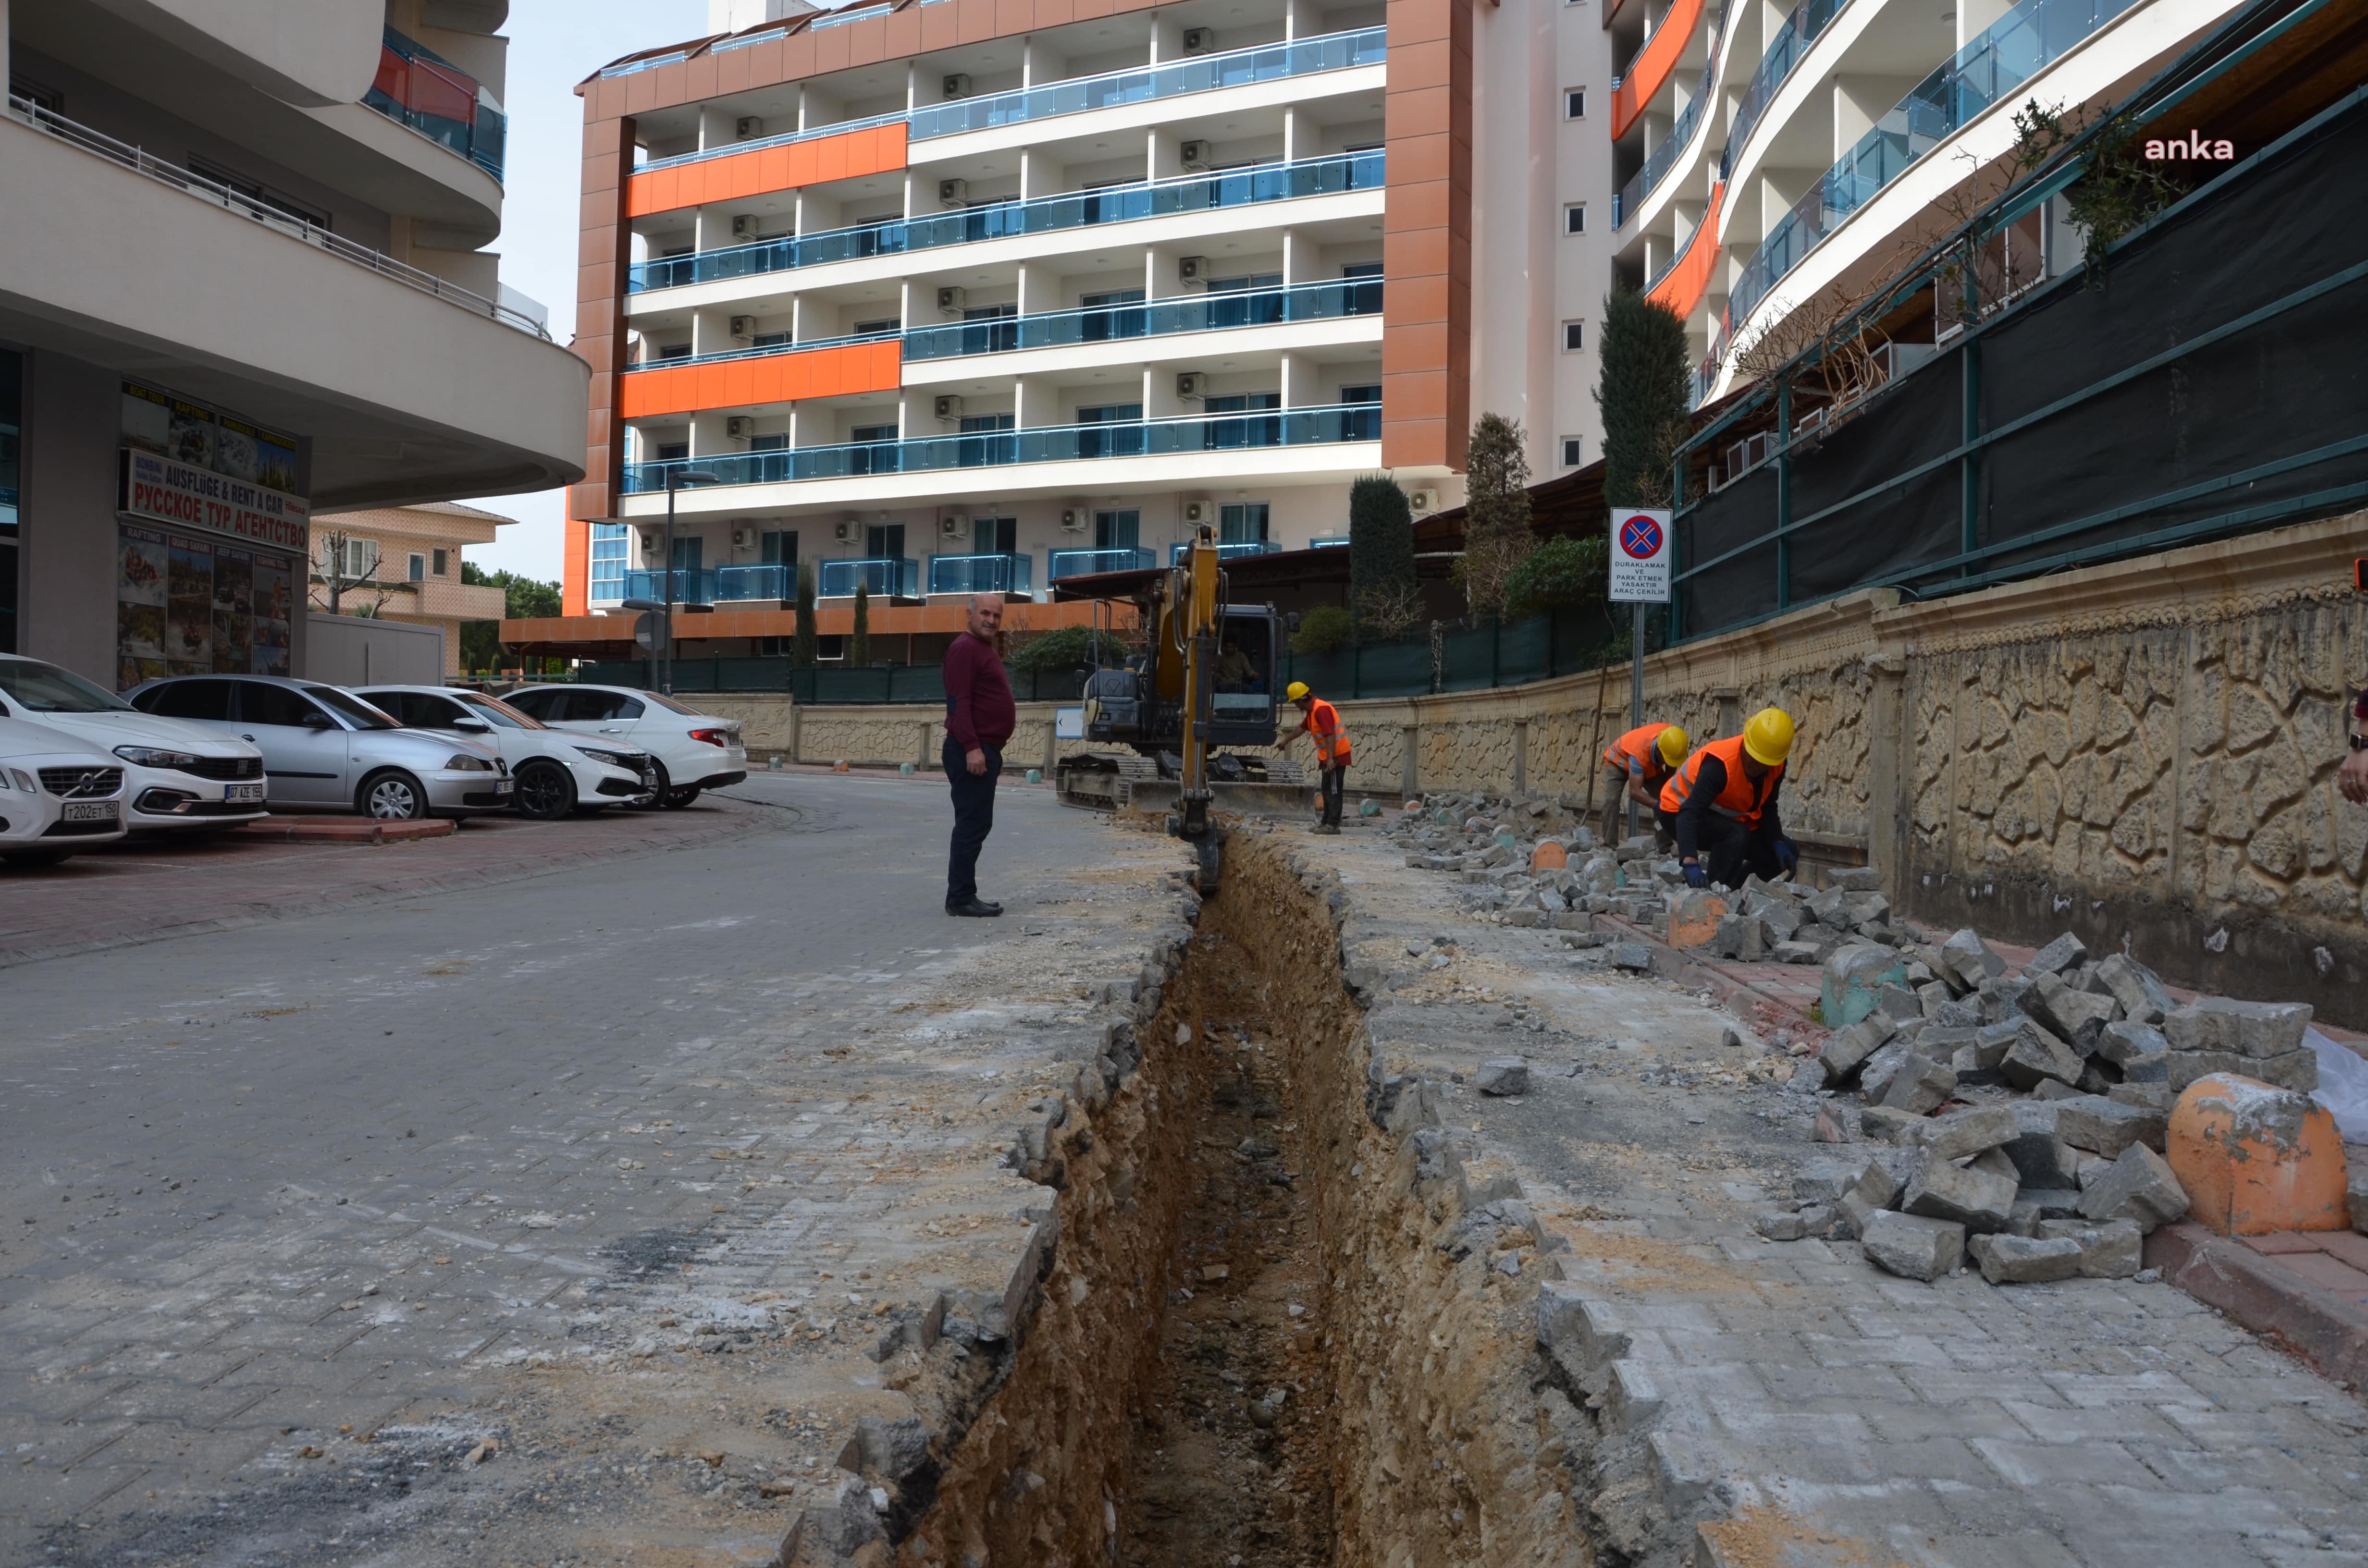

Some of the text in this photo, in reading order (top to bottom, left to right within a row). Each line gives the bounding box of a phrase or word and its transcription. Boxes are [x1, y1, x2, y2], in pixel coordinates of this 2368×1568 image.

[130, 384, 165, 405] BOAT TOUR
[175, 401, 209, 421] RAFTING
[222, 481, 229, 501] &
[231, 484, 255, 508] RENT
[257, 491, 263, 510] A
[266, 494, 283, 515] CAR
[135, 482, 306, 548] РУССКОЕ ТУР АГЕНТСТВО
[127, 527, 161, 542] RAFTING
[172, 538, 210, 552] QUAD SAFARI
[217, 547, 250, 562] JEEP SAFARI
[257, 555, 276, 567] FISHING
[231, 786, 261, 798] 07 AZE 155
[104, 803, 117, 813] 150
